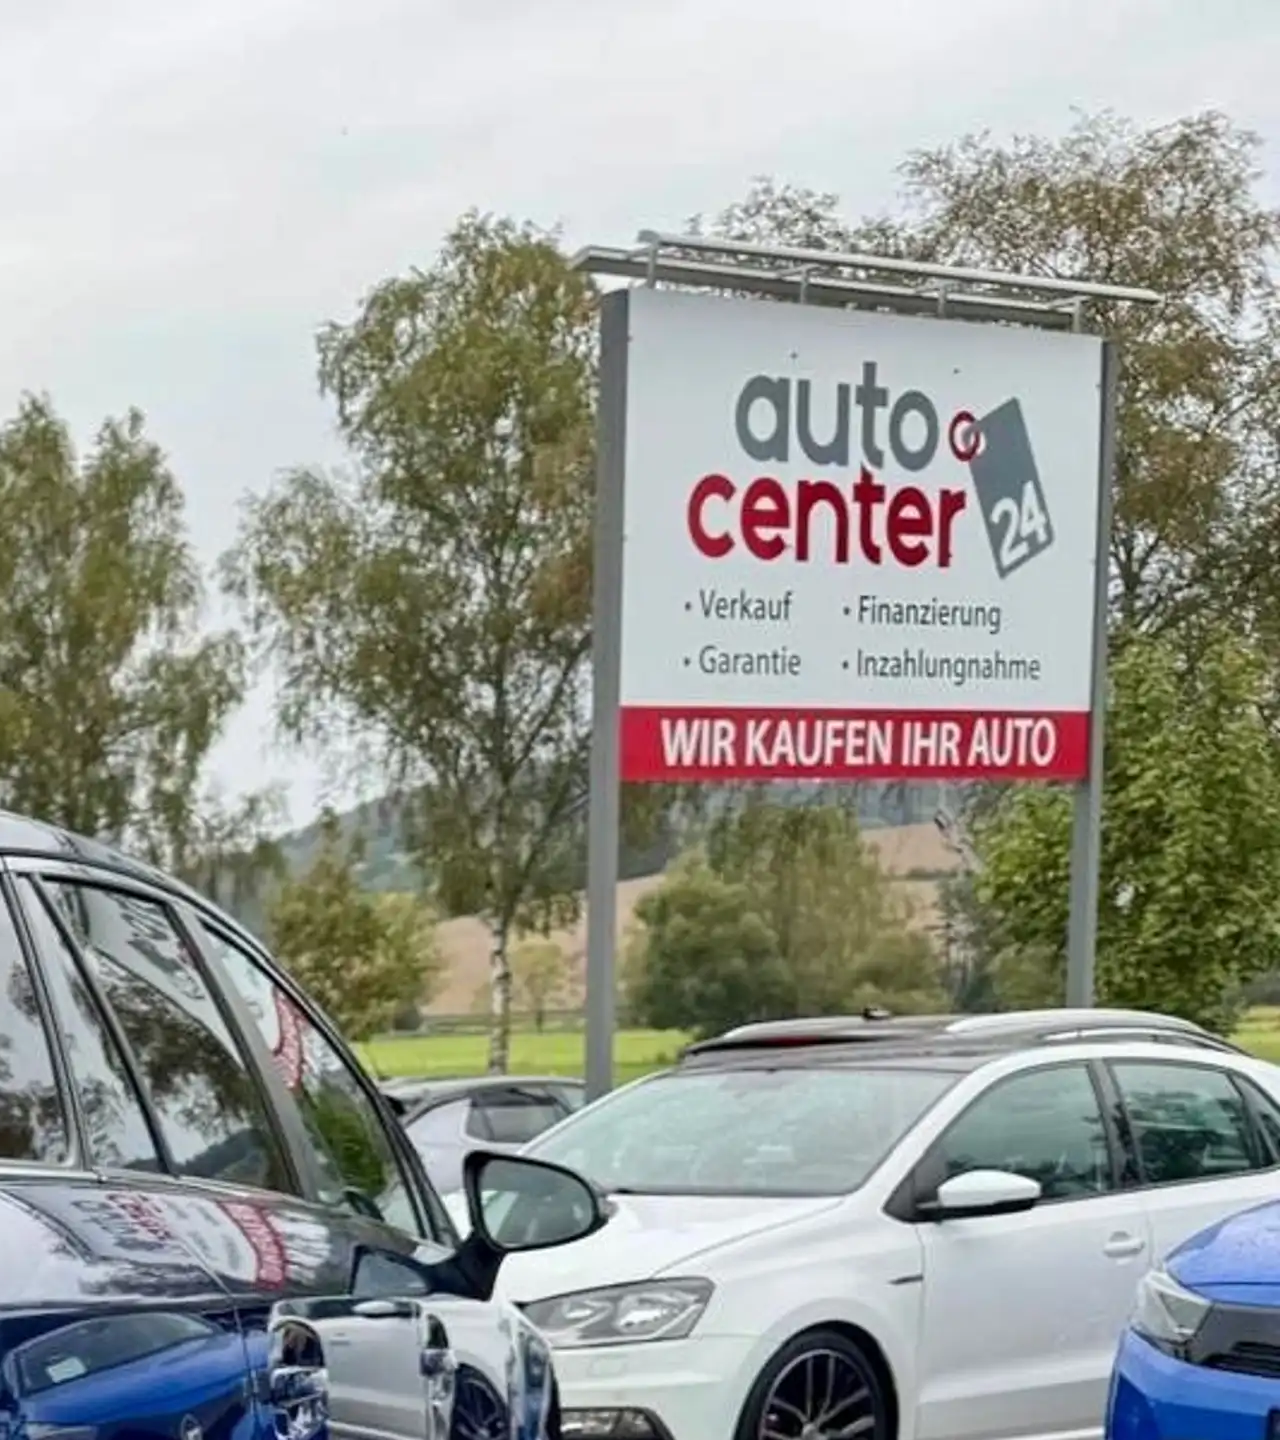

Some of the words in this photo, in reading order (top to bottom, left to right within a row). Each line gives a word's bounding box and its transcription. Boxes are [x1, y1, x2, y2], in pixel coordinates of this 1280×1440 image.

[735, 361, 939, 472] auto
[687, 462, 967, 568] center
[991, 480, 1050, 567] 24
[699, 589, 793, 622] Verkauf
[858, 594, 1002, 635] Finanzierung
[698, 644, 802, 677] Garantie
[857, 648, 1042, 686] Inzahlungnahme
[660, 718, 737, 767] WIR
[744, 718, 894, 767] KAUFEN
[901, 720, 962, 768] IHR
[967, 718, 1057, 768] AUTO
